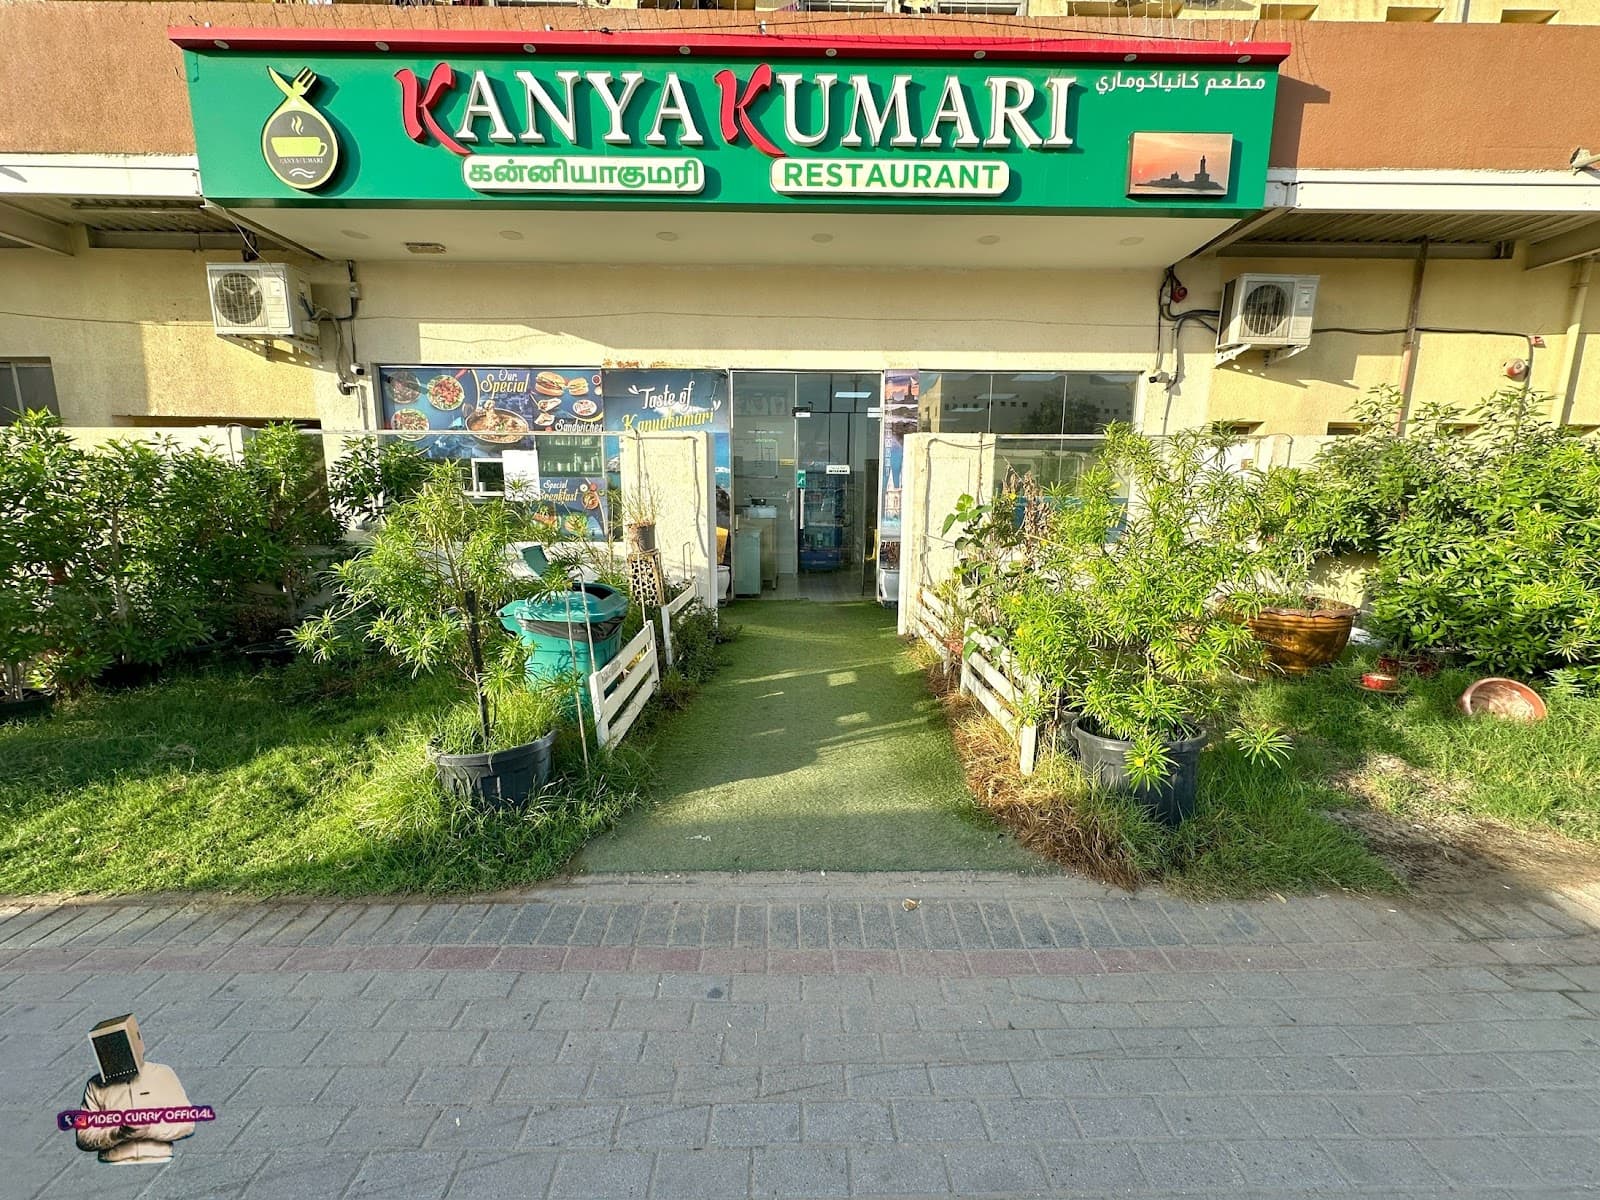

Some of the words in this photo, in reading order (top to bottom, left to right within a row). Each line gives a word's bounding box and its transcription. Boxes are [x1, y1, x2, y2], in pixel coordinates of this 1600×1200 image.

[1095, 72, 1200, 95] كانياكوماري
[1205, 73, 1266, 96] مطعم
[468, 158, 699, 189] கன்னியாகுமரி
[783, 163, 1001, 189] RESTAURANT
[480, 372, 530, 400] Special
[499, 369, 518, 381] Our
[638, 384, 676, 410] Taste
[679, 380, 696, 411] of
[554, 418, 603, 433] Sandwiches
[539, 488, 579, 504] Breakfast
[543, 479, 568, 493] Special
